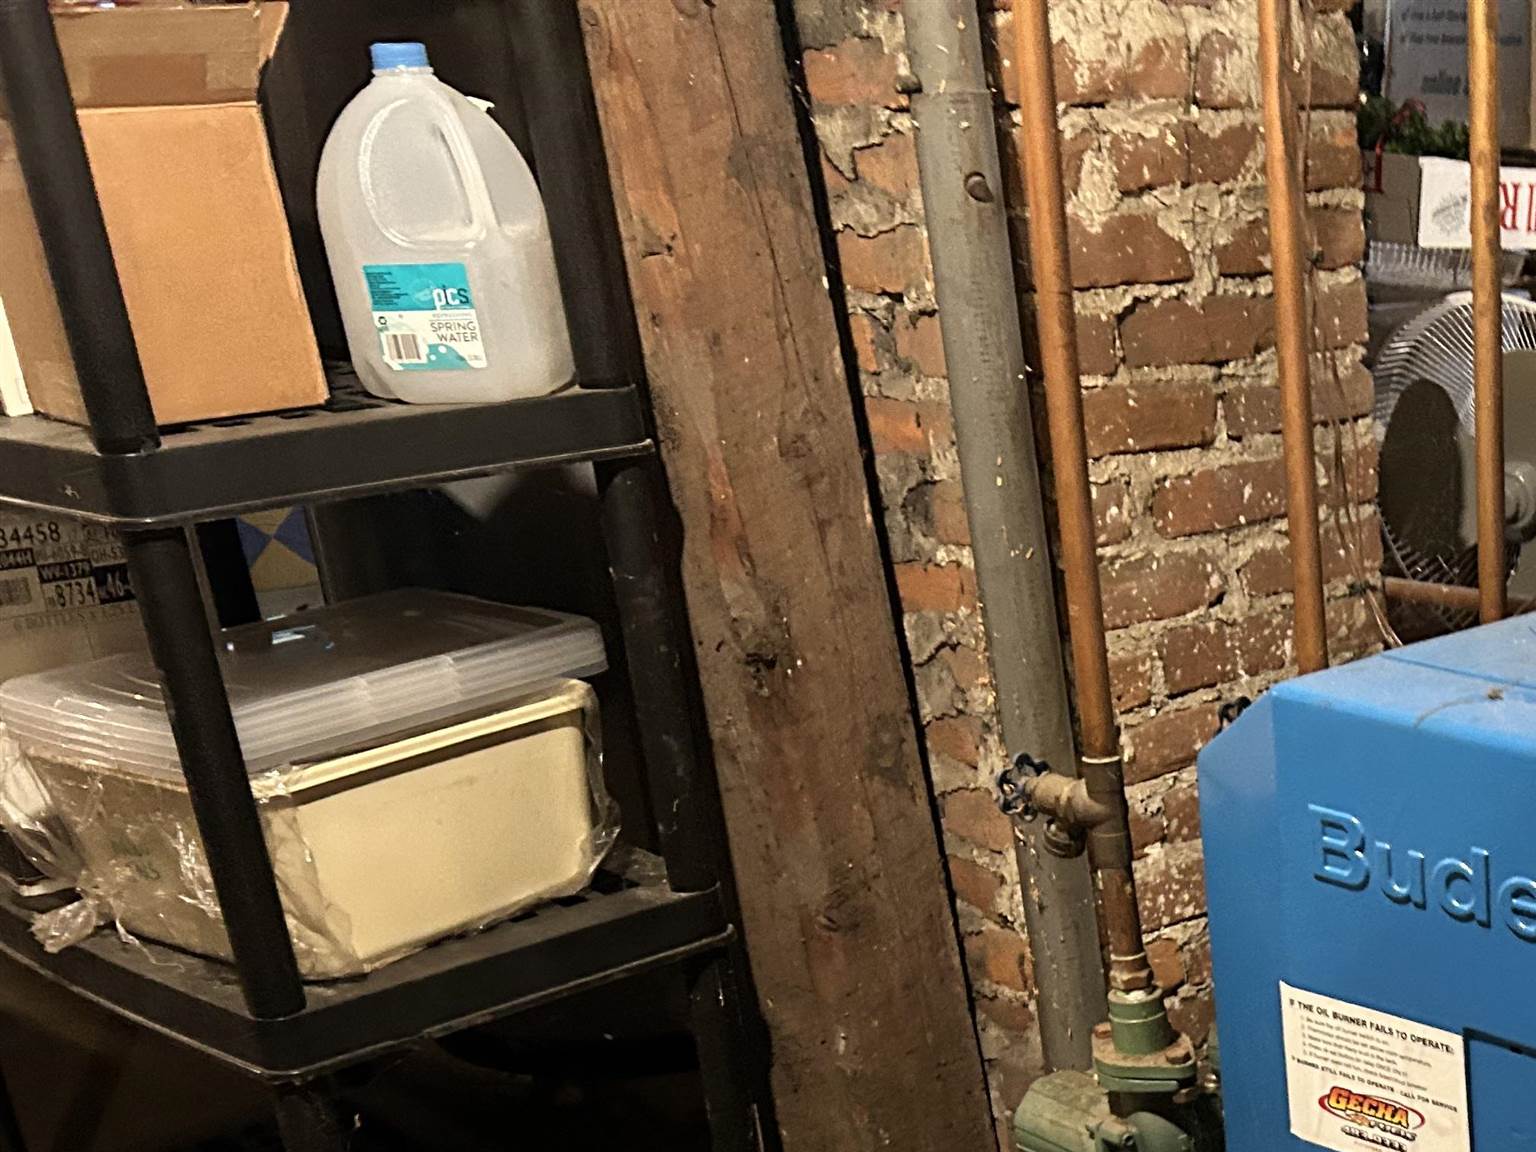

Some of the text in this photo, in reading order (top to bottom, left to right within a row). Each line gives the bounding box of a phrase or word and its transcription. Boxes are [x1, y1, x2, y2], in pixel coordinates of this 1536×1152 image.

[430, 321, 476, 332] SPRING
[437, 332, 479, 343] WATER
[1297, 1001, 1314, 1013] THE
[1316, 1006, 1330, 1018] OIL
[1332, 1011, 1368, 1029] BURNER
[1370, 1021, 1394, 1036] FAILS
[1396, 1029, 1408, 1041] TO
[1328, 1086, 1409, 1129] GECHA
